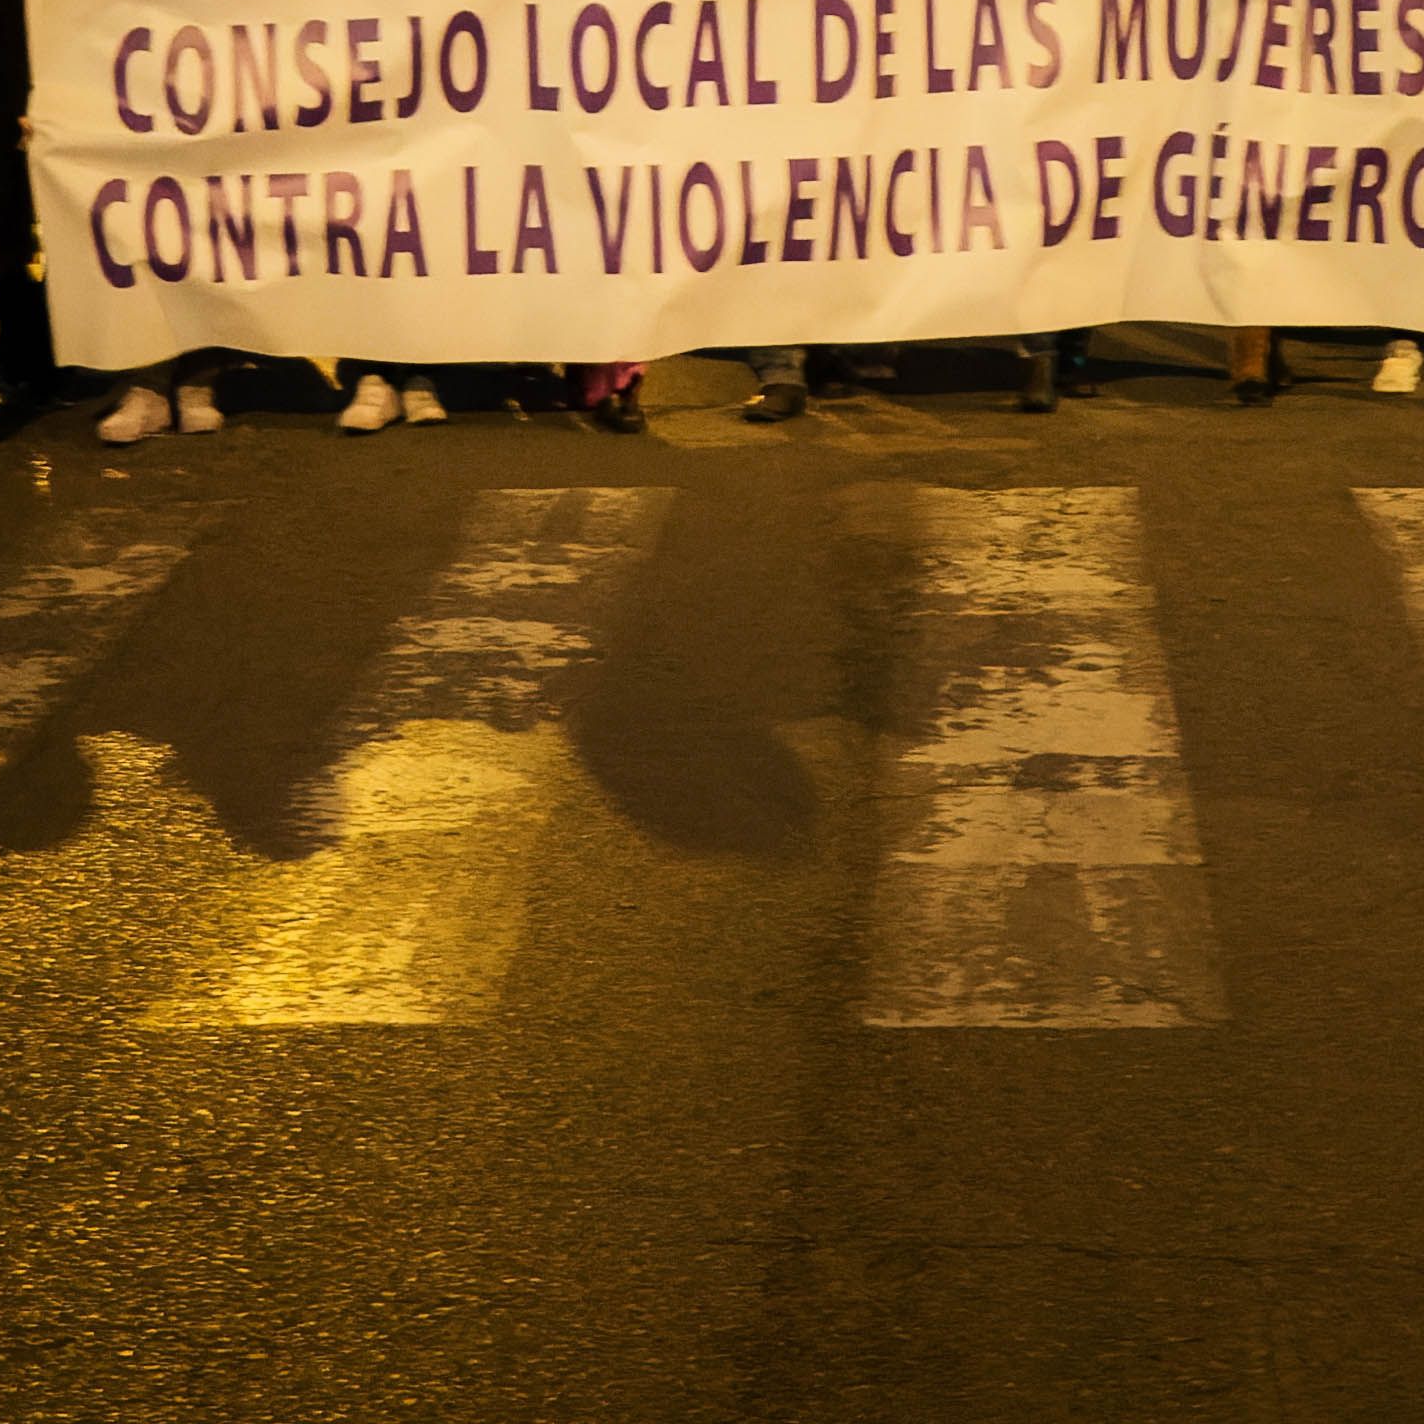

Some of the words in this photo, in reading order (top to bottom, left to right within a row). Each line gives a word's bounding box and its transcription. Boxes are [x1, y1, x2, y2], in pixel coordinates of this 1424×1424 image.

[112, 10, 490, 135] CONSEJO
[89, 167, 429, 289] CONTRA
[465, 164, 561, 277] LA
[586, 144, 1007, 275] VIOLENCIA
[1035, 135, 1125, 249] DE
